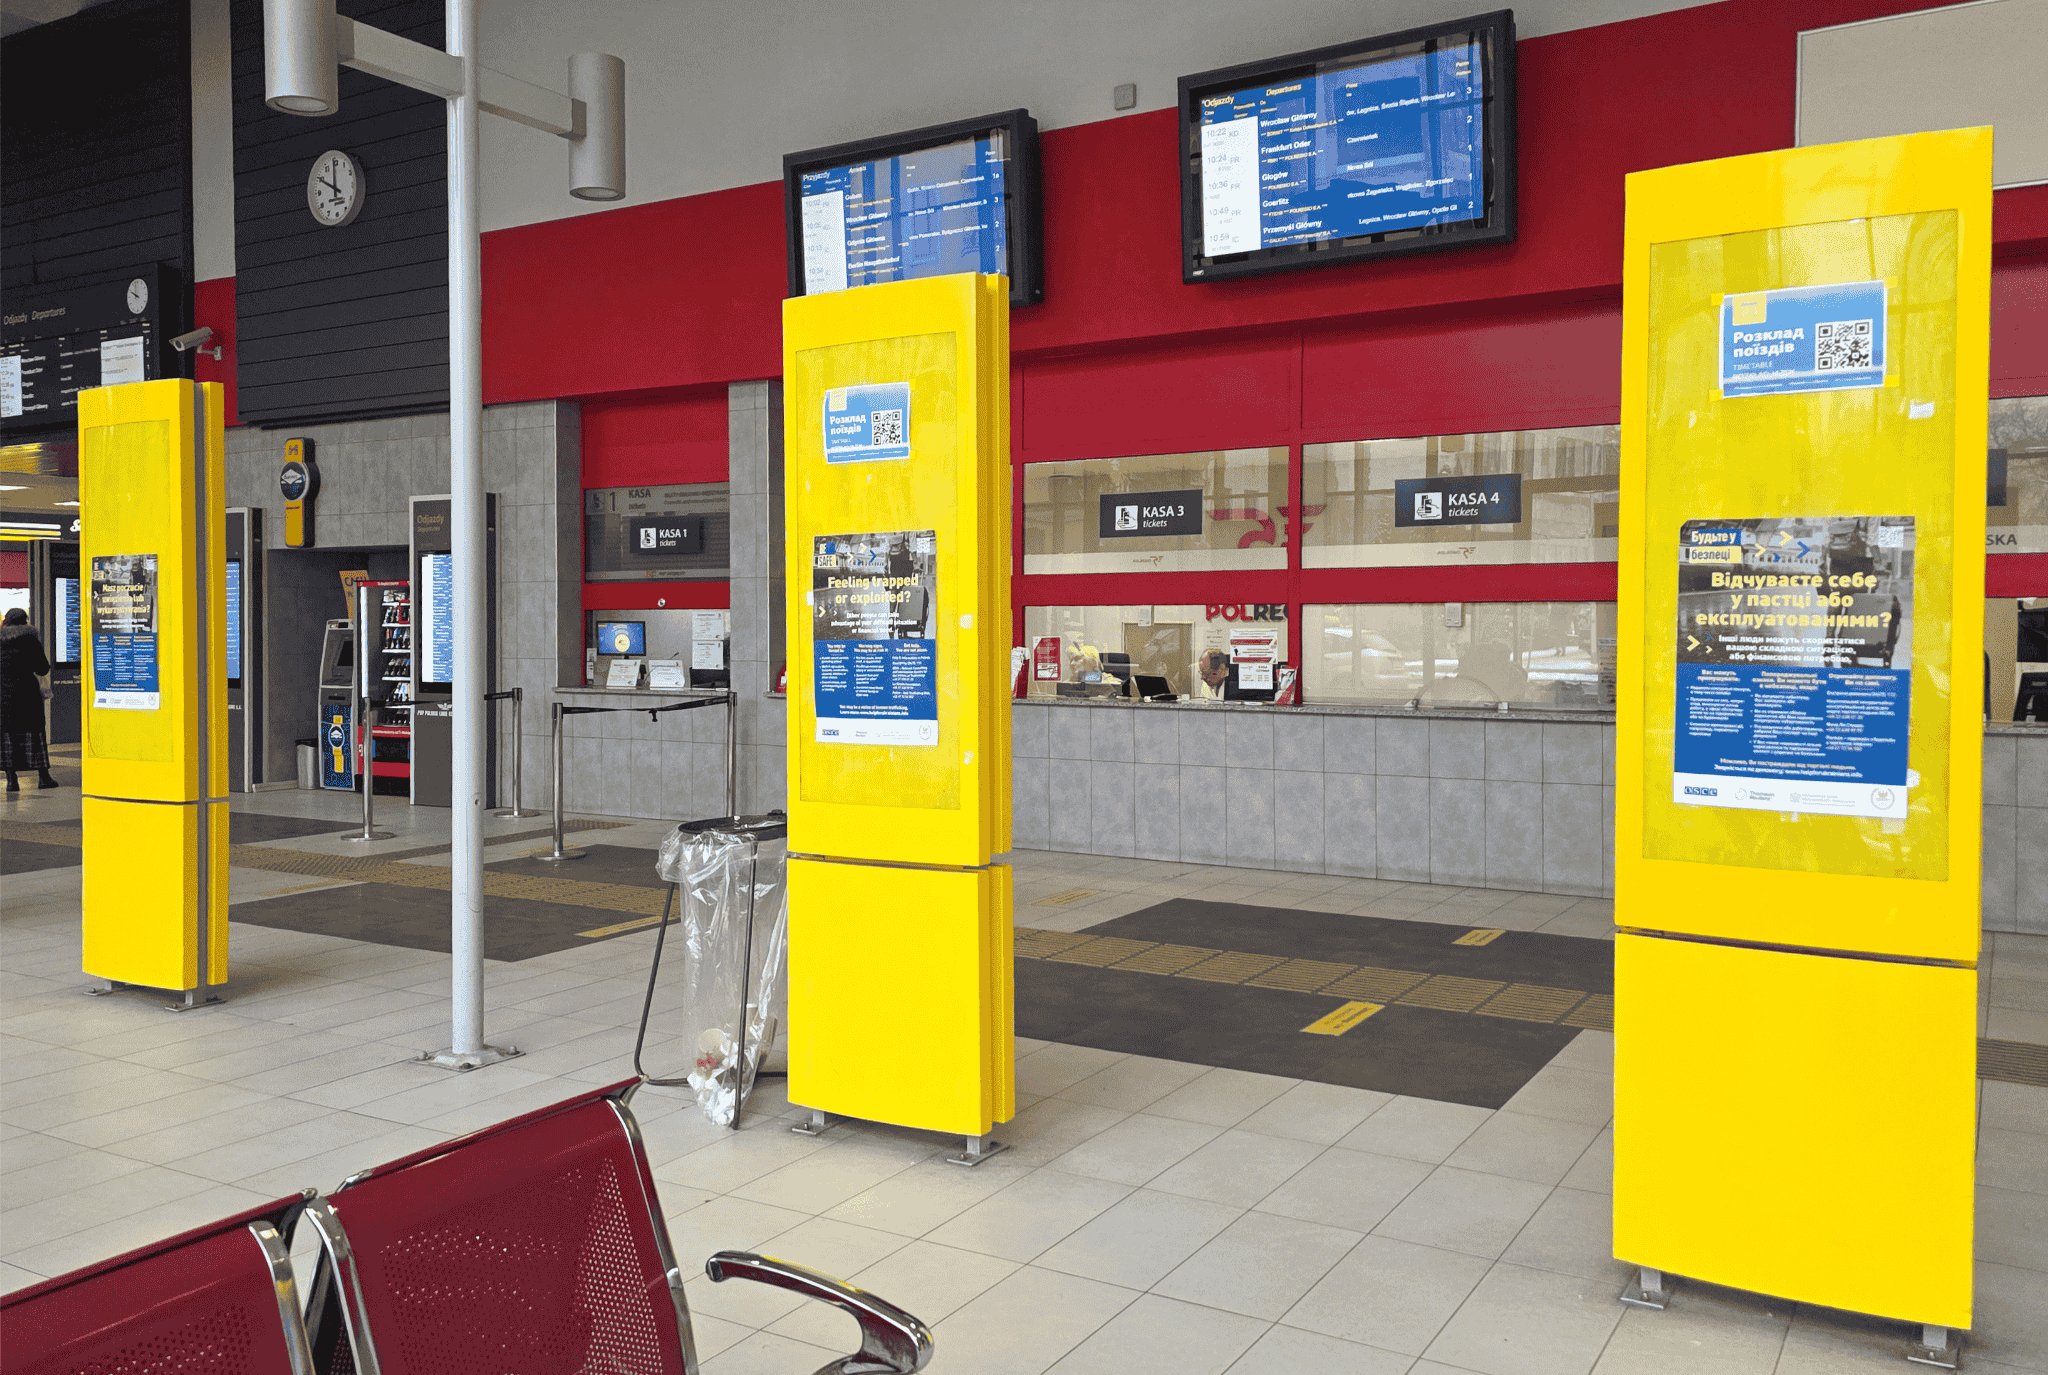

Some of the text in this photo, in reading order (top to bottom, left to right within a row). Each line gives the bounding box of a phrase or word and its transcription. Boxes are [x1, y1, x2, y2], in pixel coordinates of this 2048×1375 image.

[1204, 96, 1234, 108] Odjazdy
[1266, 84, 1302, 96] Departures
[1260, 116, 1290, 127] Wrocław
[1290, 112, 1318, 122] Główny
[1262, 142, 1292, 154] Frankfurt
[1294, 140, 1312, 149] Oder
[1466, 115, 1472, 124] 2
[1262, 198, 1290, 208] Goerlitz
[1296, 220, 1322, 230] Główny
[1468, 201, 1474, 209] 2
[4, 314, 28, 326] Odjazdy
[1733, 328, 1804, 345] Розклад
[1733, 341, 1795, 358] поїздів
[830, 414, 866, 426] Розклад
[831, 423, 862, 436] поїздів
[628, 488, 651, 499] KASA
[1448, 492, 1500, 506] KASA 4
[1143, 505, 1184, 518] KASA 3
[1448, 507, 1478, 517] tickets
[417, 514, 444, 526] Odjazdy
[1143, 519, 1167, 528] tickets
[660, 528, 687, 538] KASA 1
[1691, 530, 1736, 546] Будьте у
[1692, 549, 1730, 562] безпеці
[828, 573, 918, 590] Feeling trapped
[1711, 572, 1878, 590] Відчуваєте себе
[836, 590, 912, 604] or exploited?
[1732, 592, 1854, 609] у пастці або
[1695, 612, 1892, 630] експлуатованими?
[1765, 636, 1800, 644] можуть
[1801, 637, 1866, 645] скористатися
[1747, 654, 1802, 662] фінансовою
